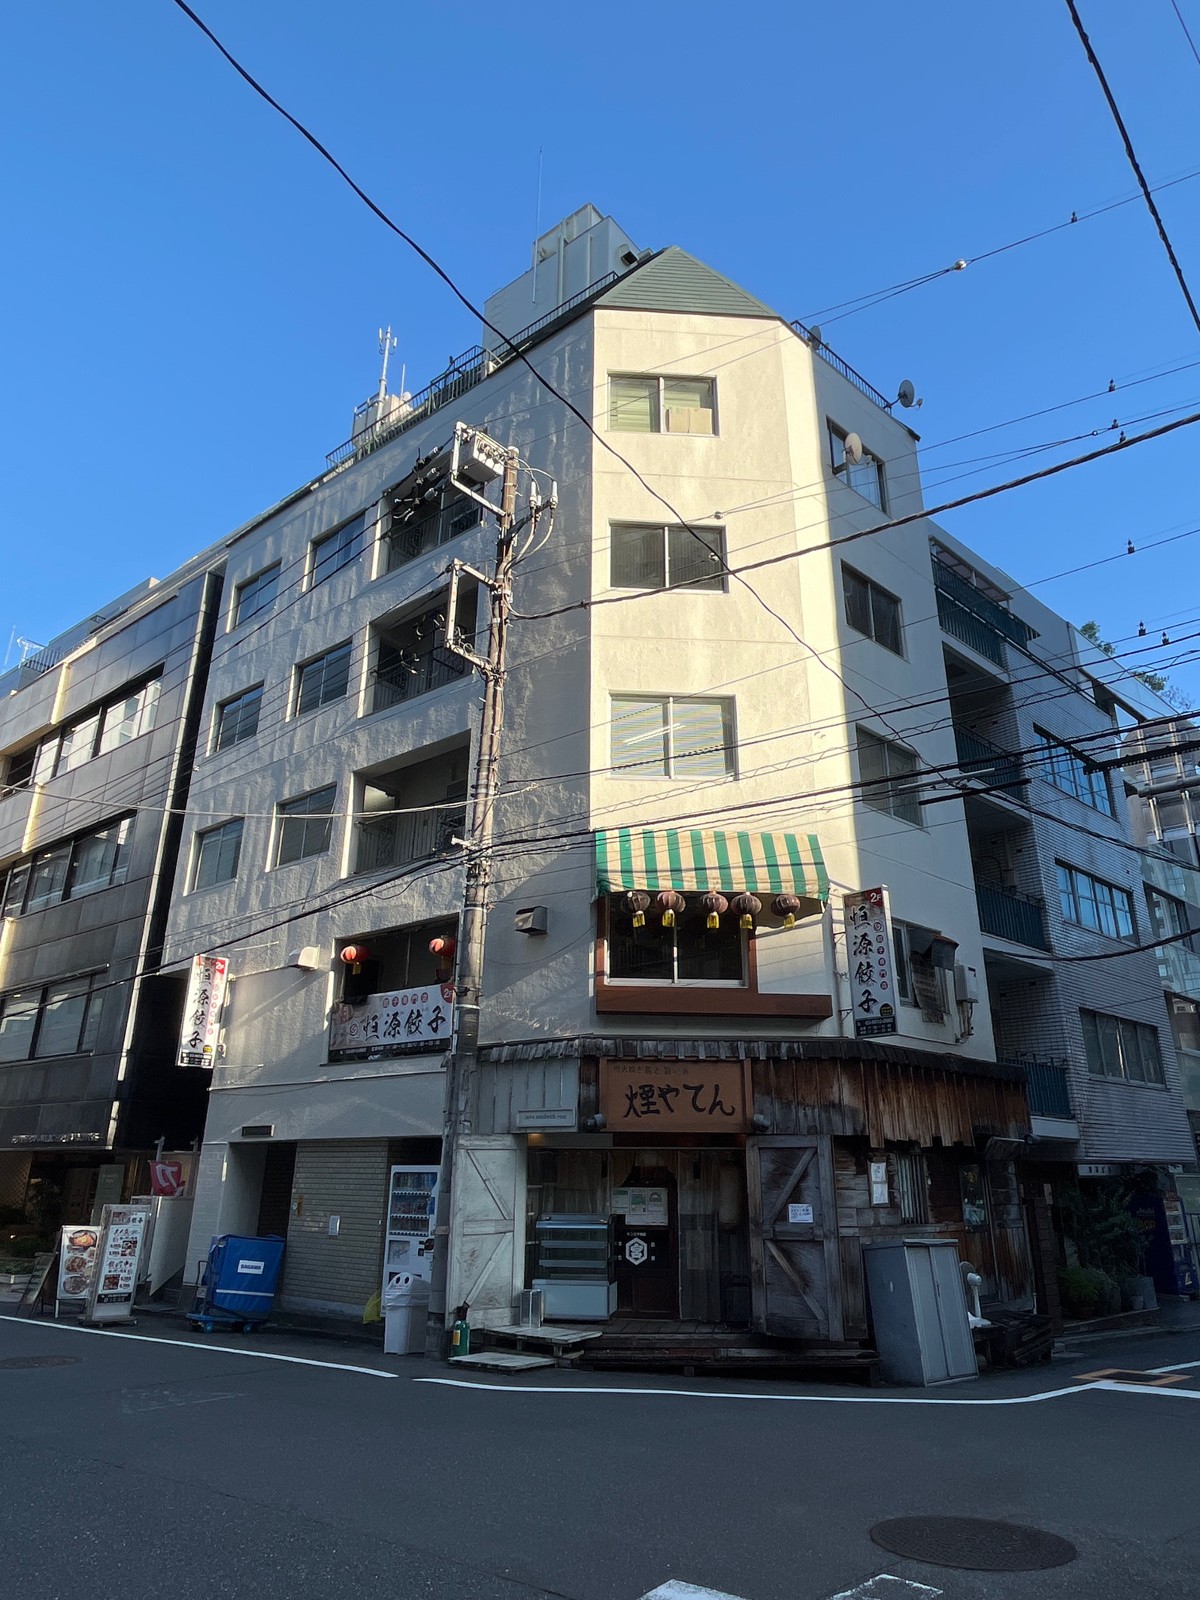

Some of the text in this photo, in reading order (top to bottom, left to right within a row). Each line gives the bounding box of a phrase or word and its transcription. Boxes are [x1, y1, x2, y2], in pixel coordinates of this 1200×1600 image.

[870, 893, 881, 903] 2F
[623, 1083, 736, 1118] 煙やてん
